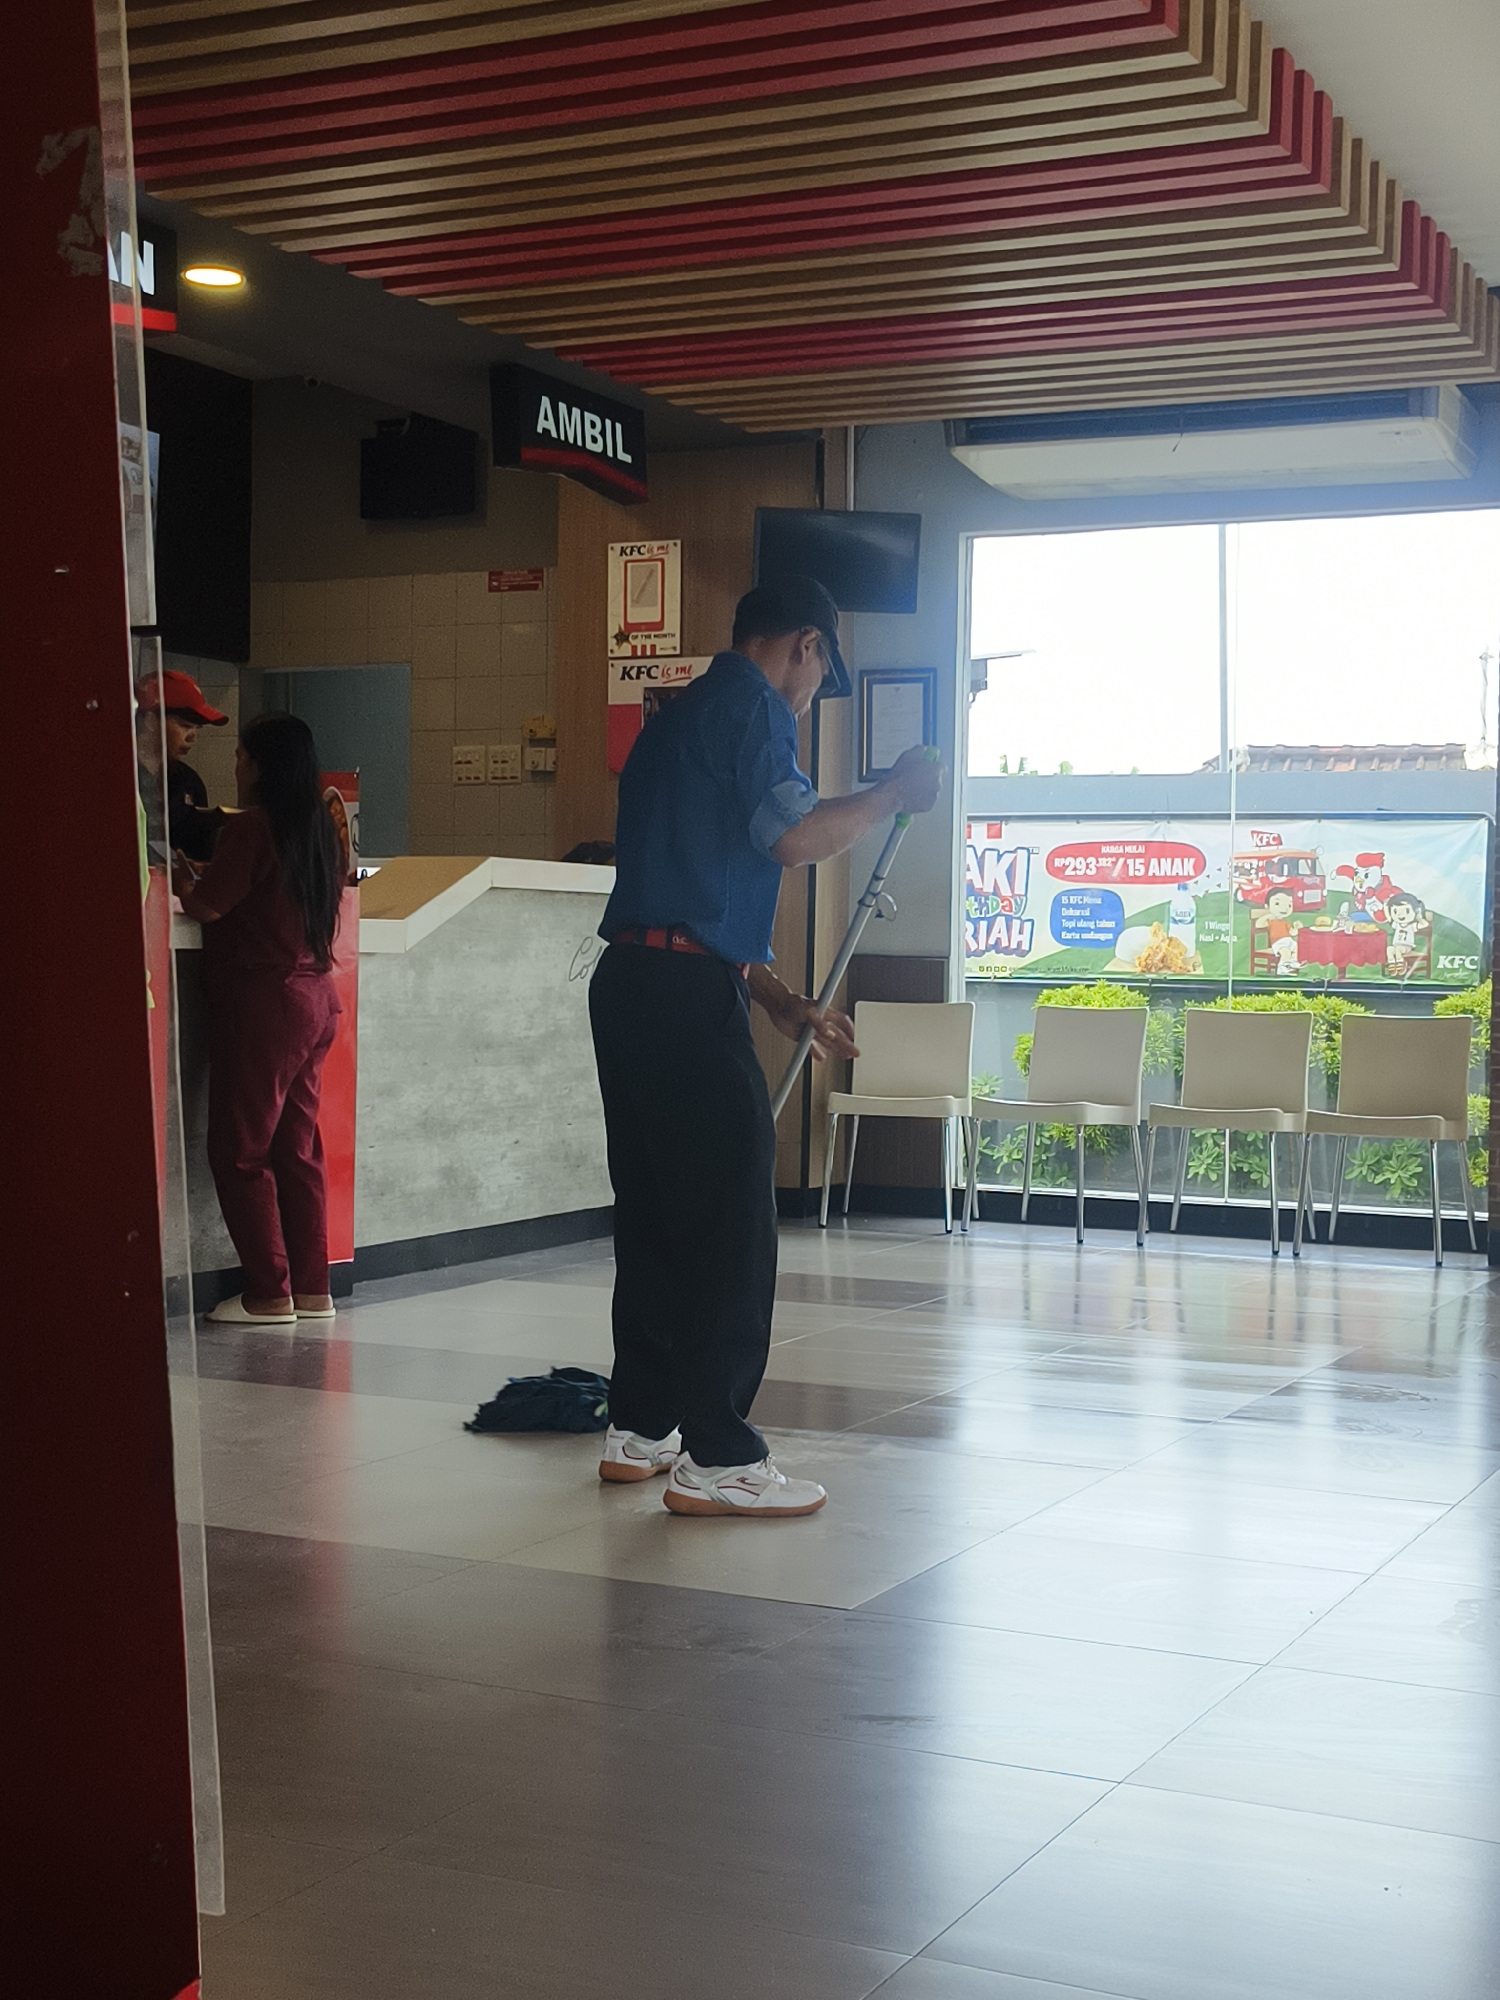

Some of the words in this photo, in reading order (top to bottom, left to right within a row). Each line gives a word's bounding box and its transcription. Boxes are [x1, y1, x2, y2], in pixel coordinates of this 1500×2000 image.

[536, 395, 632, 464] AMBIL
[619, 545, 647, 557] KFC
[620, 665, 659, 680] KFC
[661, 664, 671, 679] is
[675, 664, 694, 676] me
[1252, 832, 1279, 847] KFC
[1148, 857, 1196, 877] ANAK
[1436, 955, 1479, 969] KFC
